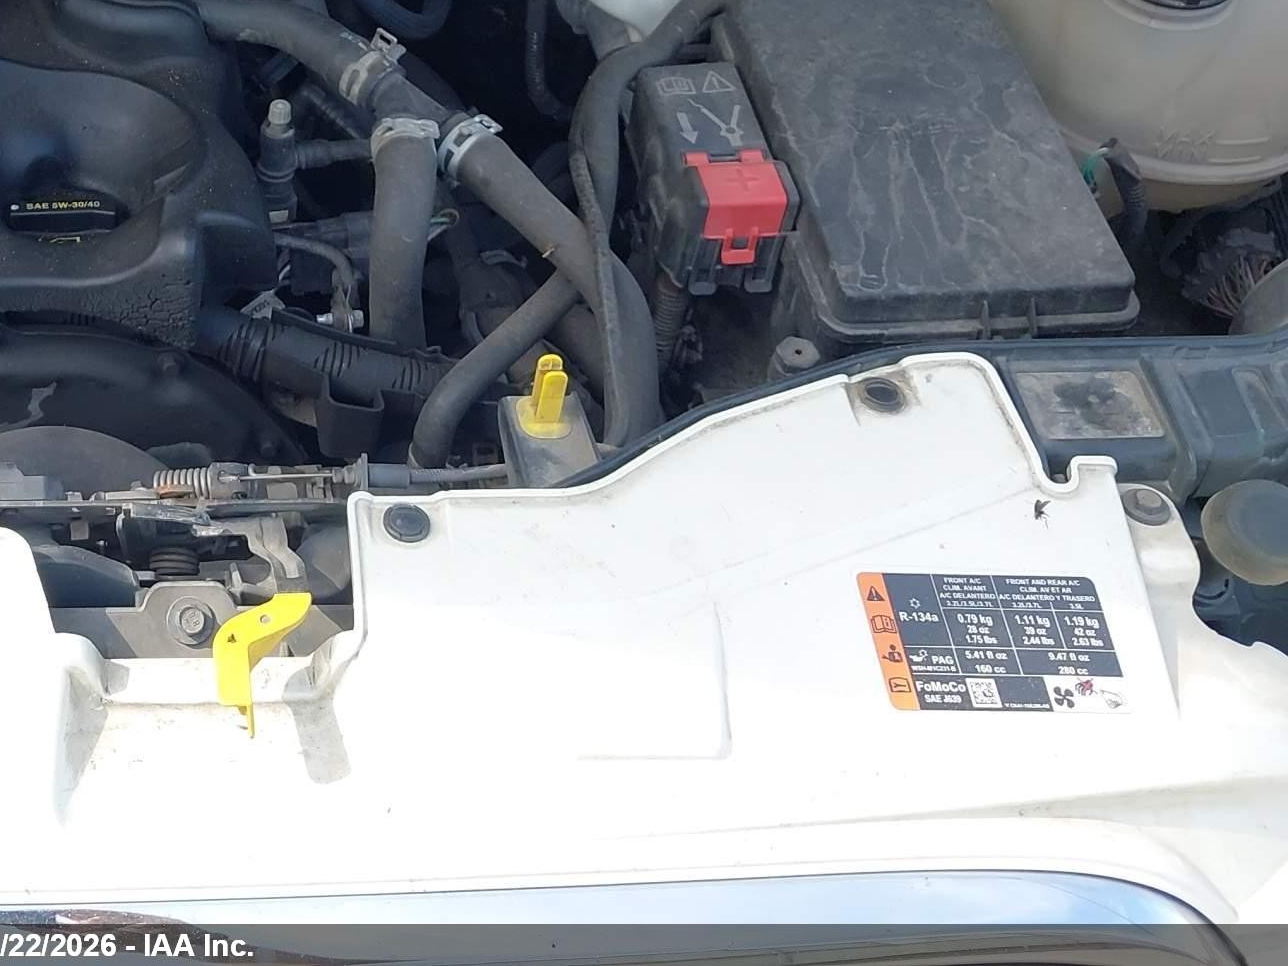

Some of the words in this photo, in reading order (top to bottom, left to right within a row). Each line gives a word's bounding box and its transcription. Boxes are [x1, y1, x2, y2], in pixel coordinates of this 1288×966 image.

[26, 202, 49, 210] SAE
[52, 200, 100, 209] 5W-30/40
[899, 611, 939, 622] R-134a
[957, 613, 978, 623] 0.79
[979, 614, 993, 626] kg
[1014, 615, 1036, 625] 1.11
[1037, 615, 1050, 627] kg
[1064, 616, 1085, 626] 1.19
[1086, 616, 1100, 629] kg
[965, 635, 983, 644] 1.75
[984, 635, 998, 644] lbs
[1041, 636, 1055, 645] lbs
[1090, 638, 1104, 647] lbs
[931, 655, 954, 665] PAG
[964, 650, 984, 659] 5.41
[995, 652, 1008, 660] oz
[1078, 653, 1090, 661] oz
[974, 665, 992, 674] 160
[994, 666, 1007, 674] cc
[915, 680, 966, 693] FoMoCo
[924, 694, 942, 703] SAE
